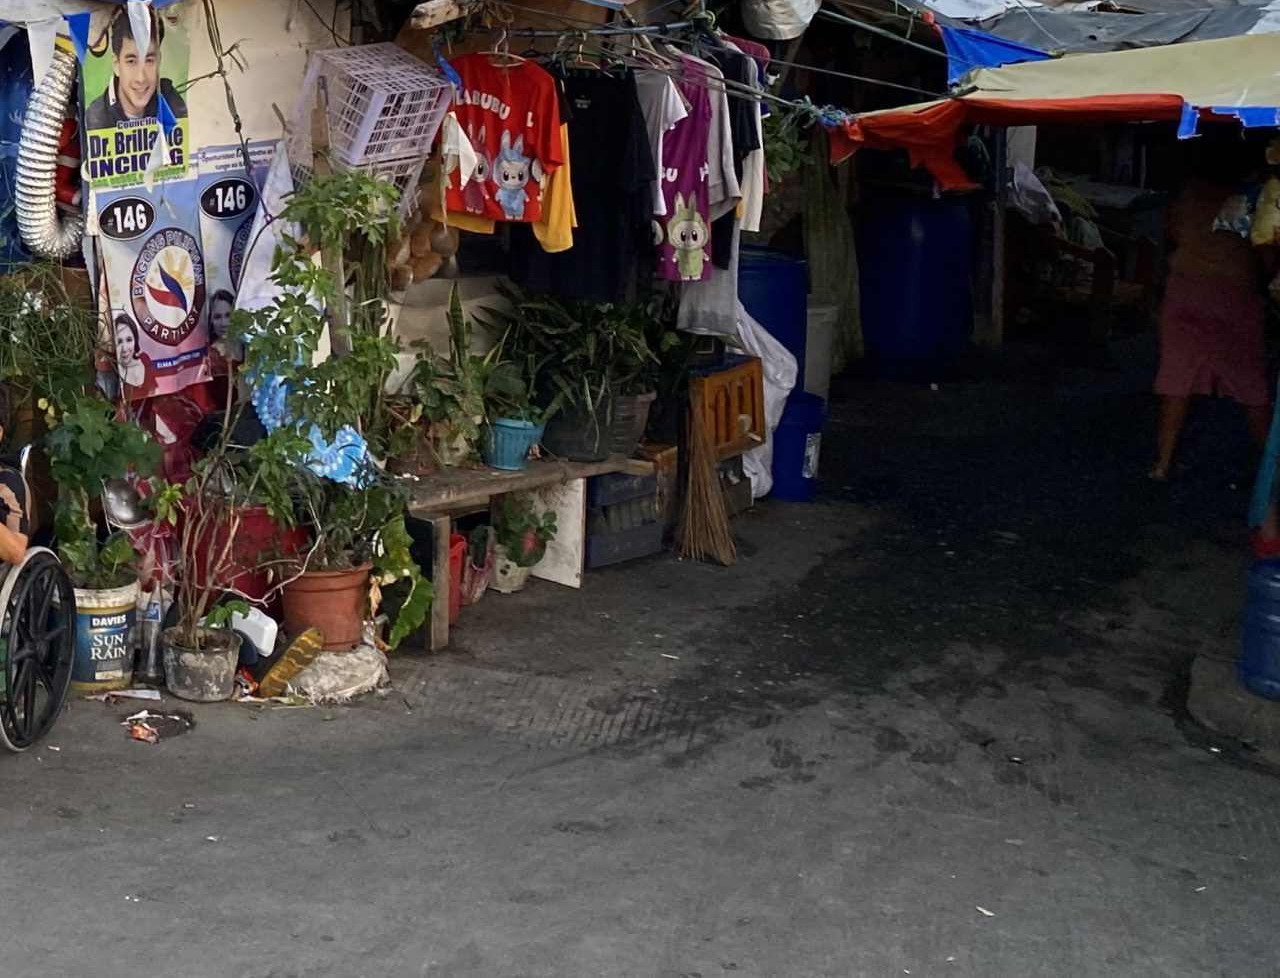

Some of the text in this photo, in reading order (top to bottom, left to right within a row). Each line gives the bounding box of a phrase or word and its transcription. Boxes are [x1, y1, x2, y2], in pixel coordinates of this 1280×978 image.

[455, 87, 511, 120] LABUBU
[117, 117, 159, 130] Councilo
[89, 126, 184, 159] Dr. Brillate
[90, 147, 184, 179] INCIOG
[133, 233, 166, 298] BAGONG
[92, 614, 127, 626] DAVIES
